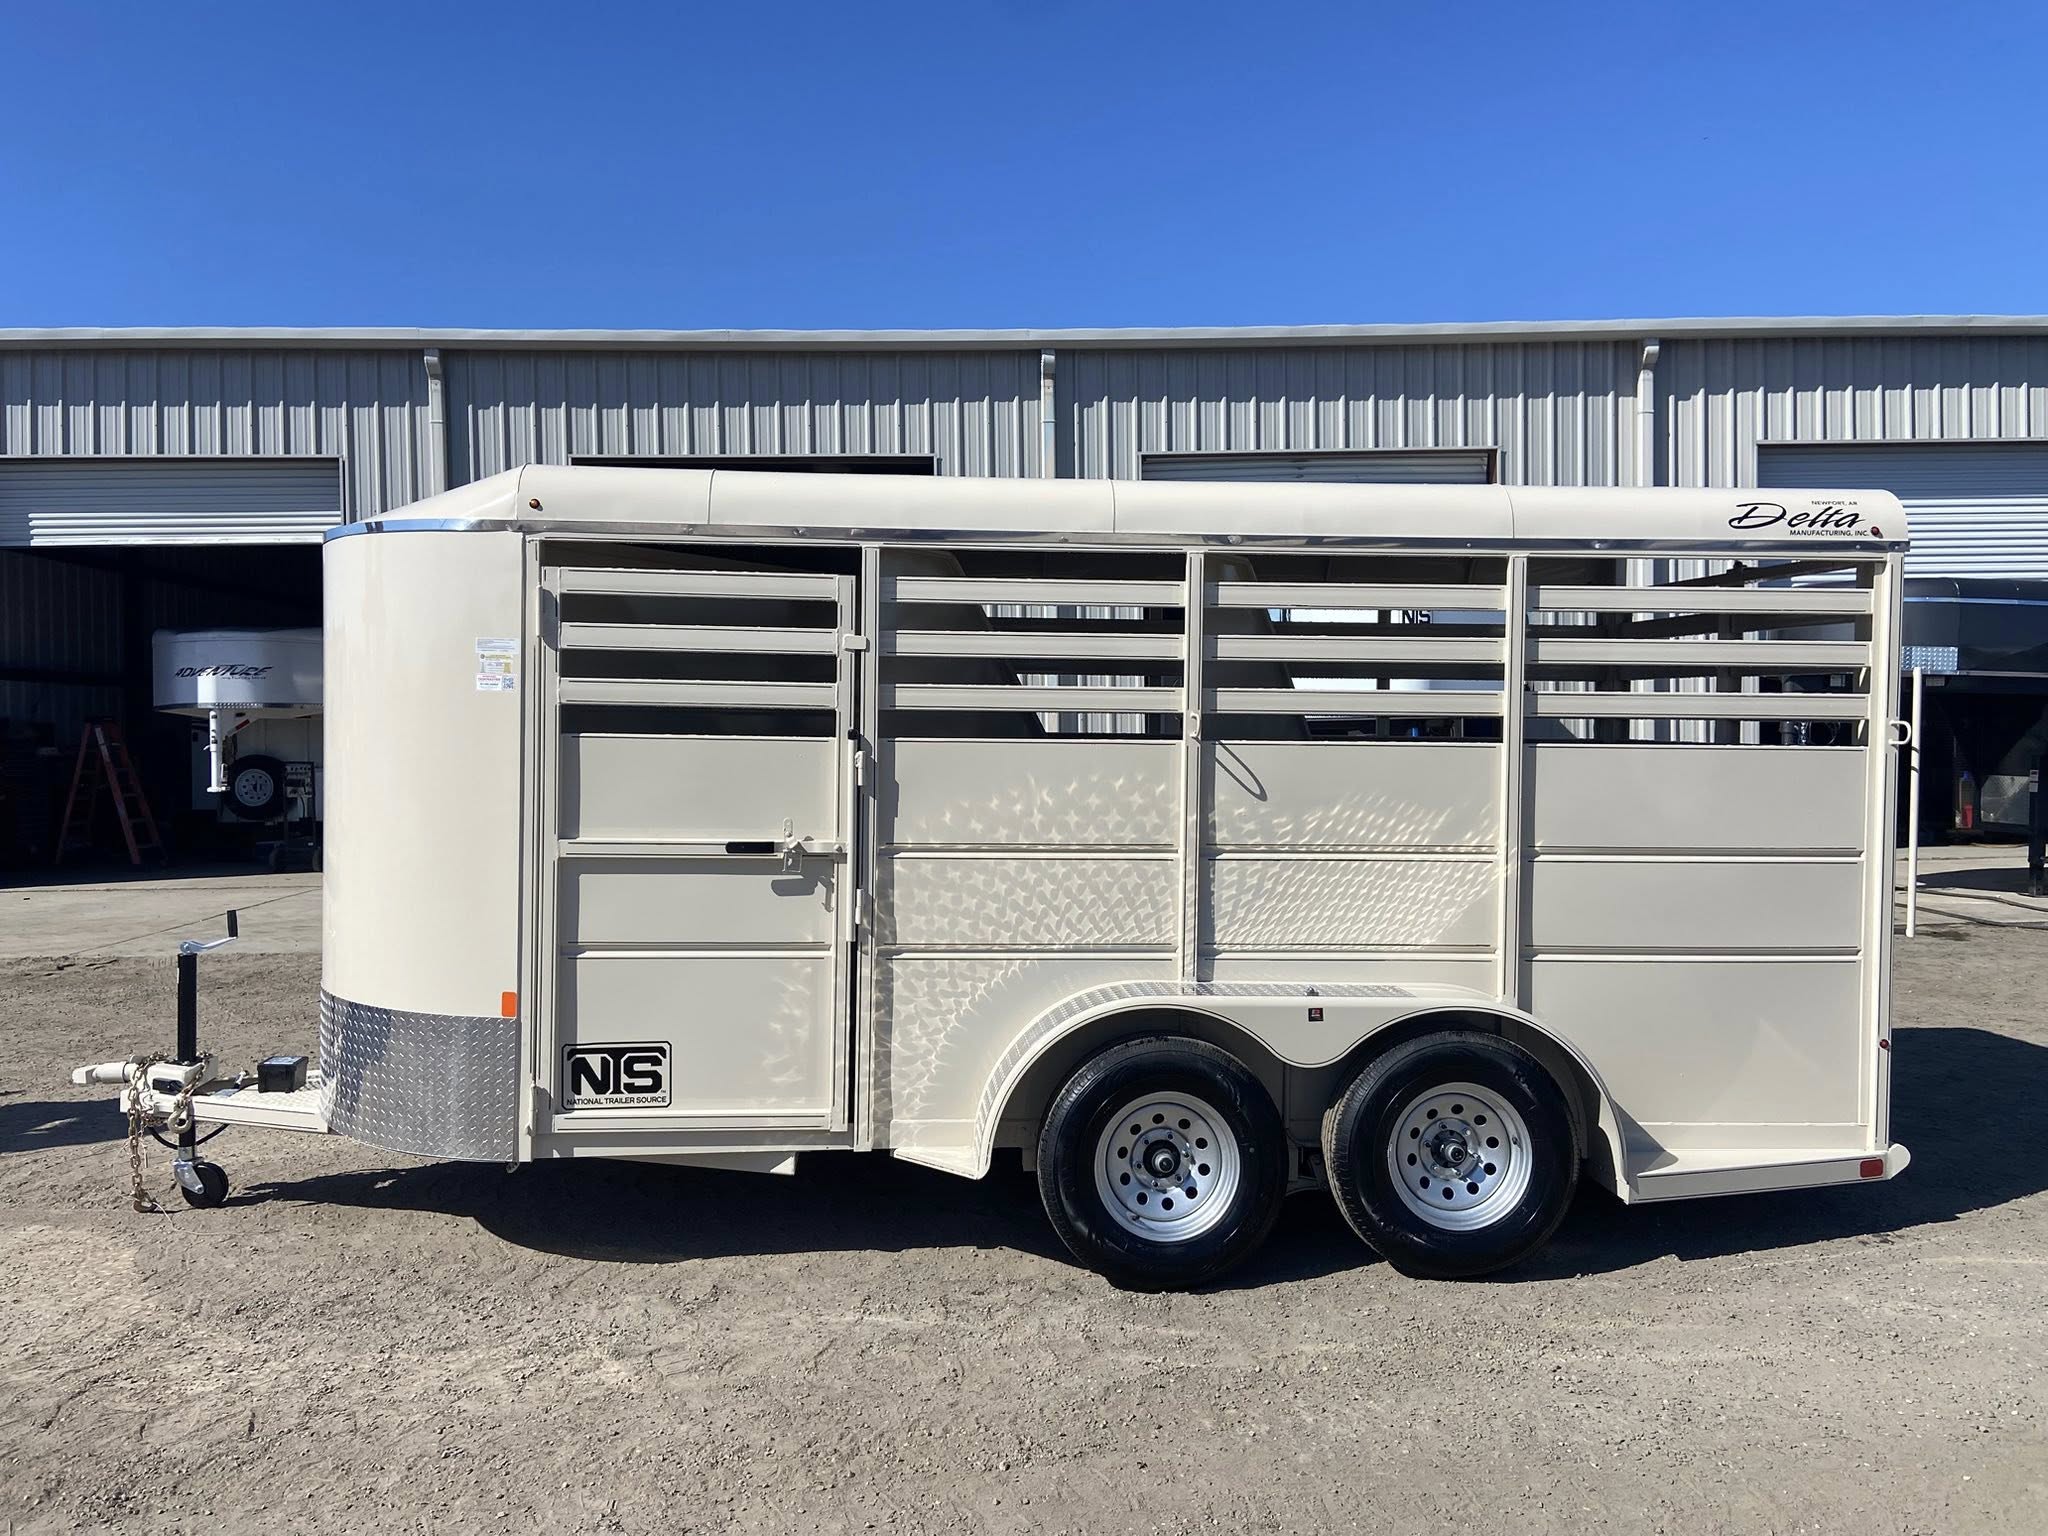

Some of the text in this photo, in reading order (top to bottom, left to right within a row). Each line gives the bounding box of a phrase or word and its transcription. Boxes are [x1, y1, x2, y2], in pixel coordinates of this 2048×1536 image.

[1728, 502, 1865, 529] Delta
[175, 664, 273, 677] ADVENTURE
[567, 1046, 667, 1095] NTS
[566, 1097, 603, 1105] NATIONAL
[636, 1096, 667, 1104] SOURCE
